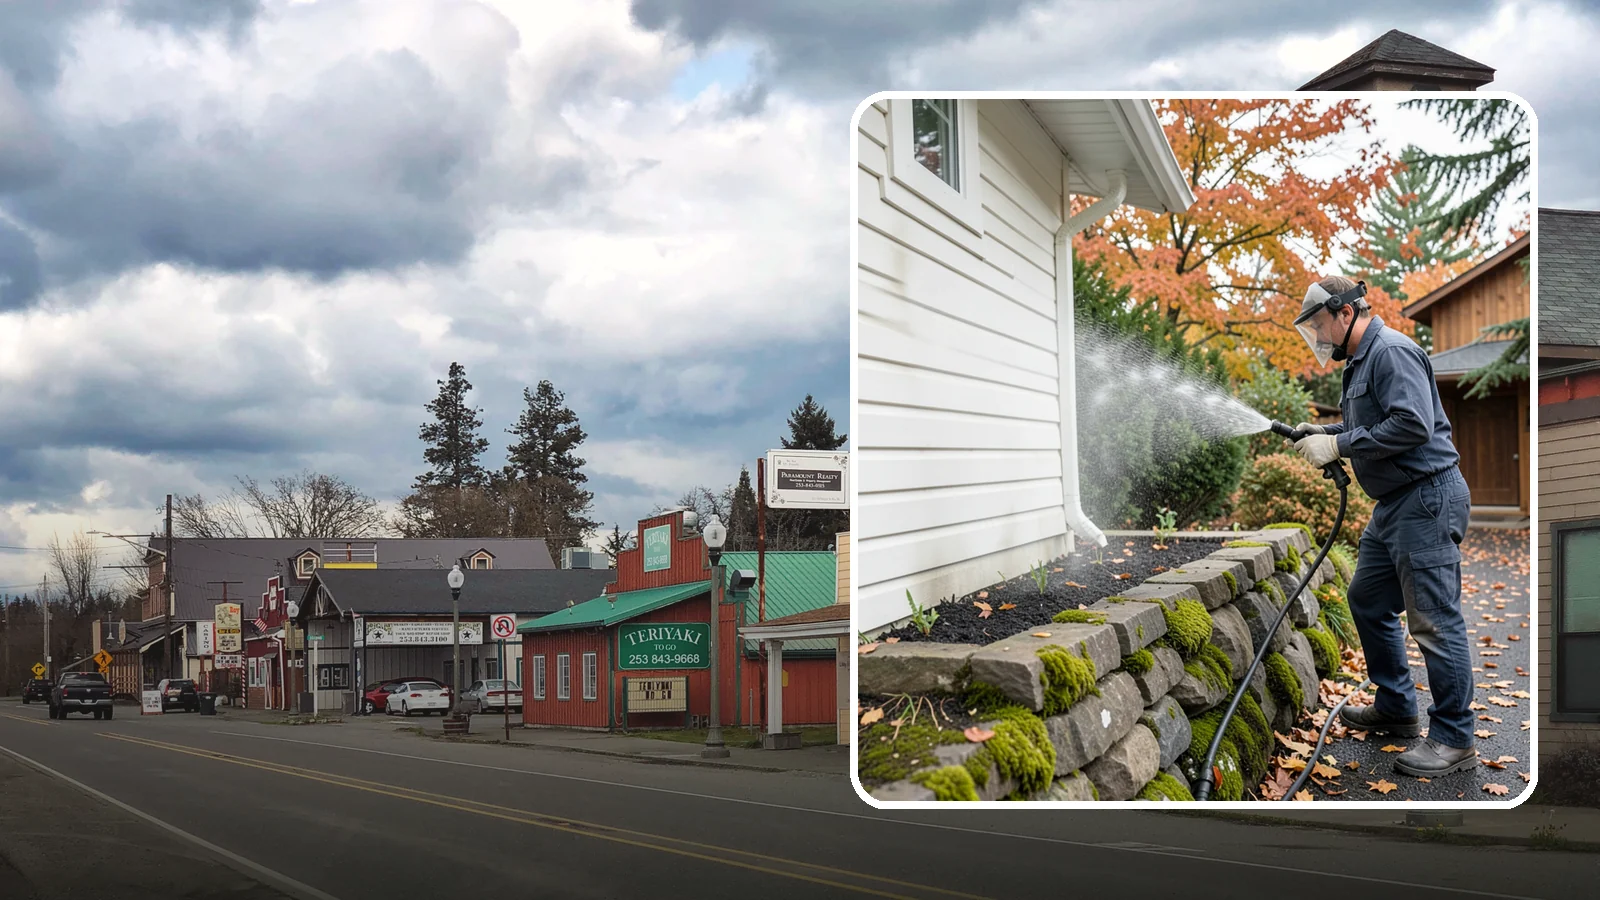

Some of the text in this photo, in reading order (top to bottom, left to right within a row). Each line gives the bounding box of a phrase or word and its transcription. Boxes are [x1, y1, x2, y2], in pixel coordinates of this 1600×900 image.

[781, 471, 815, 479] PARAMOUNT
[646, 531, 668, 549] TERIYAKI
[624, 627, 703, 646] TERIYAKI
[628, 653, 700, 665] 253 843-9668
